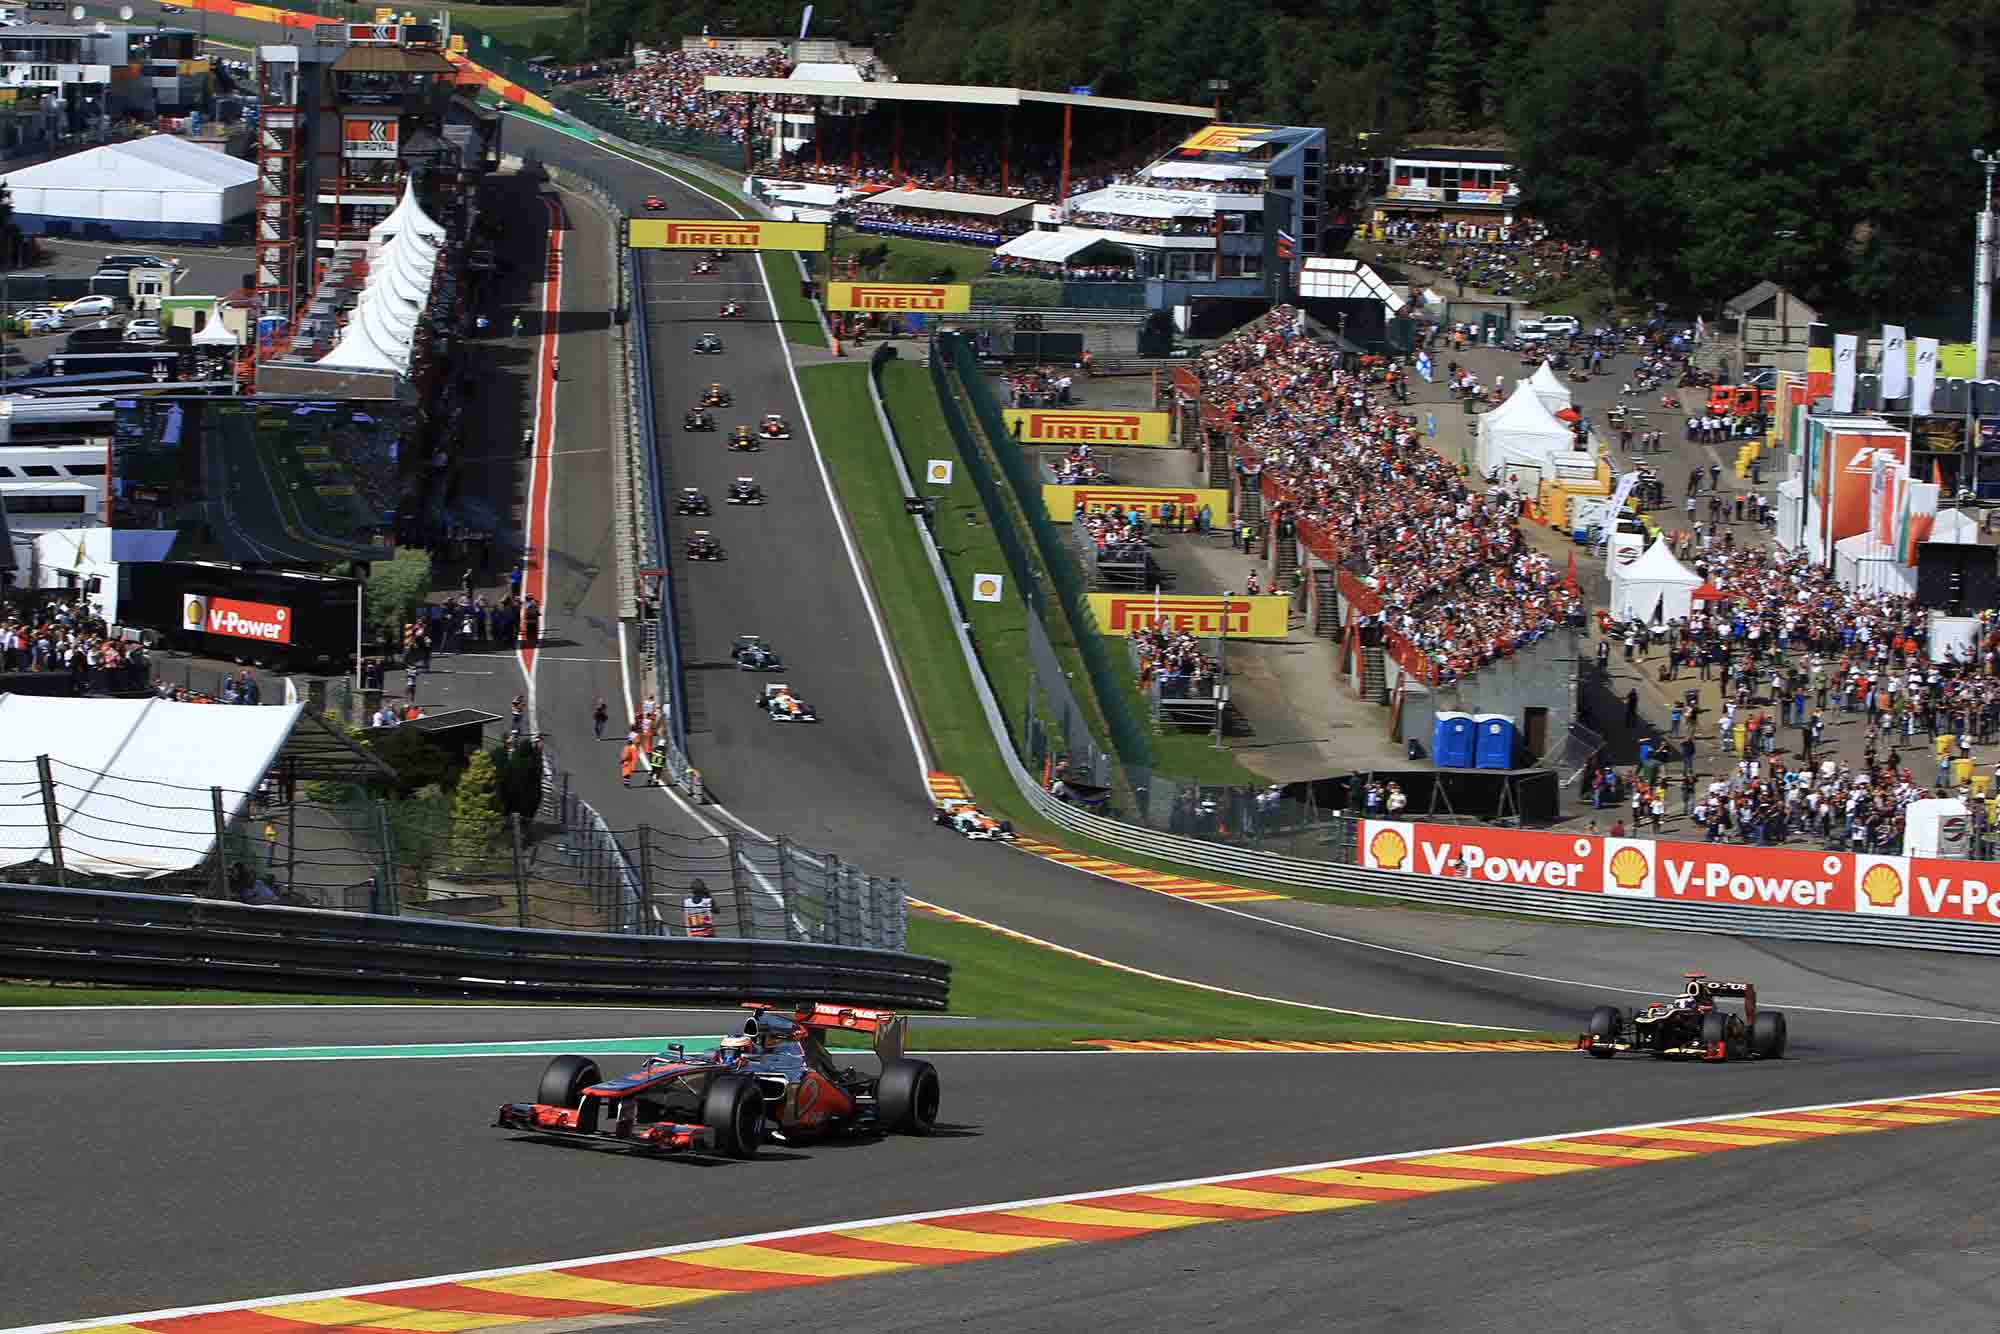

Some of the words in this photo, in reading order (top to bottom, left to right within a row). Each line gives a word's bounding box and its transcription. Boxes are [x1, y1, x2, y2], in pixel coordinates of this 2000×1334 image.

[666, 224, 761, 246] PIRELLI
[850, 287, 945, 309] PIRELLI
[1029, 414, 1140, 440] PIRELLI
[210, 609, 282, 639] V-Power
[1421, 841, 1583, 887] V-Power
[1664, 860, 1833, 905] V-Power
